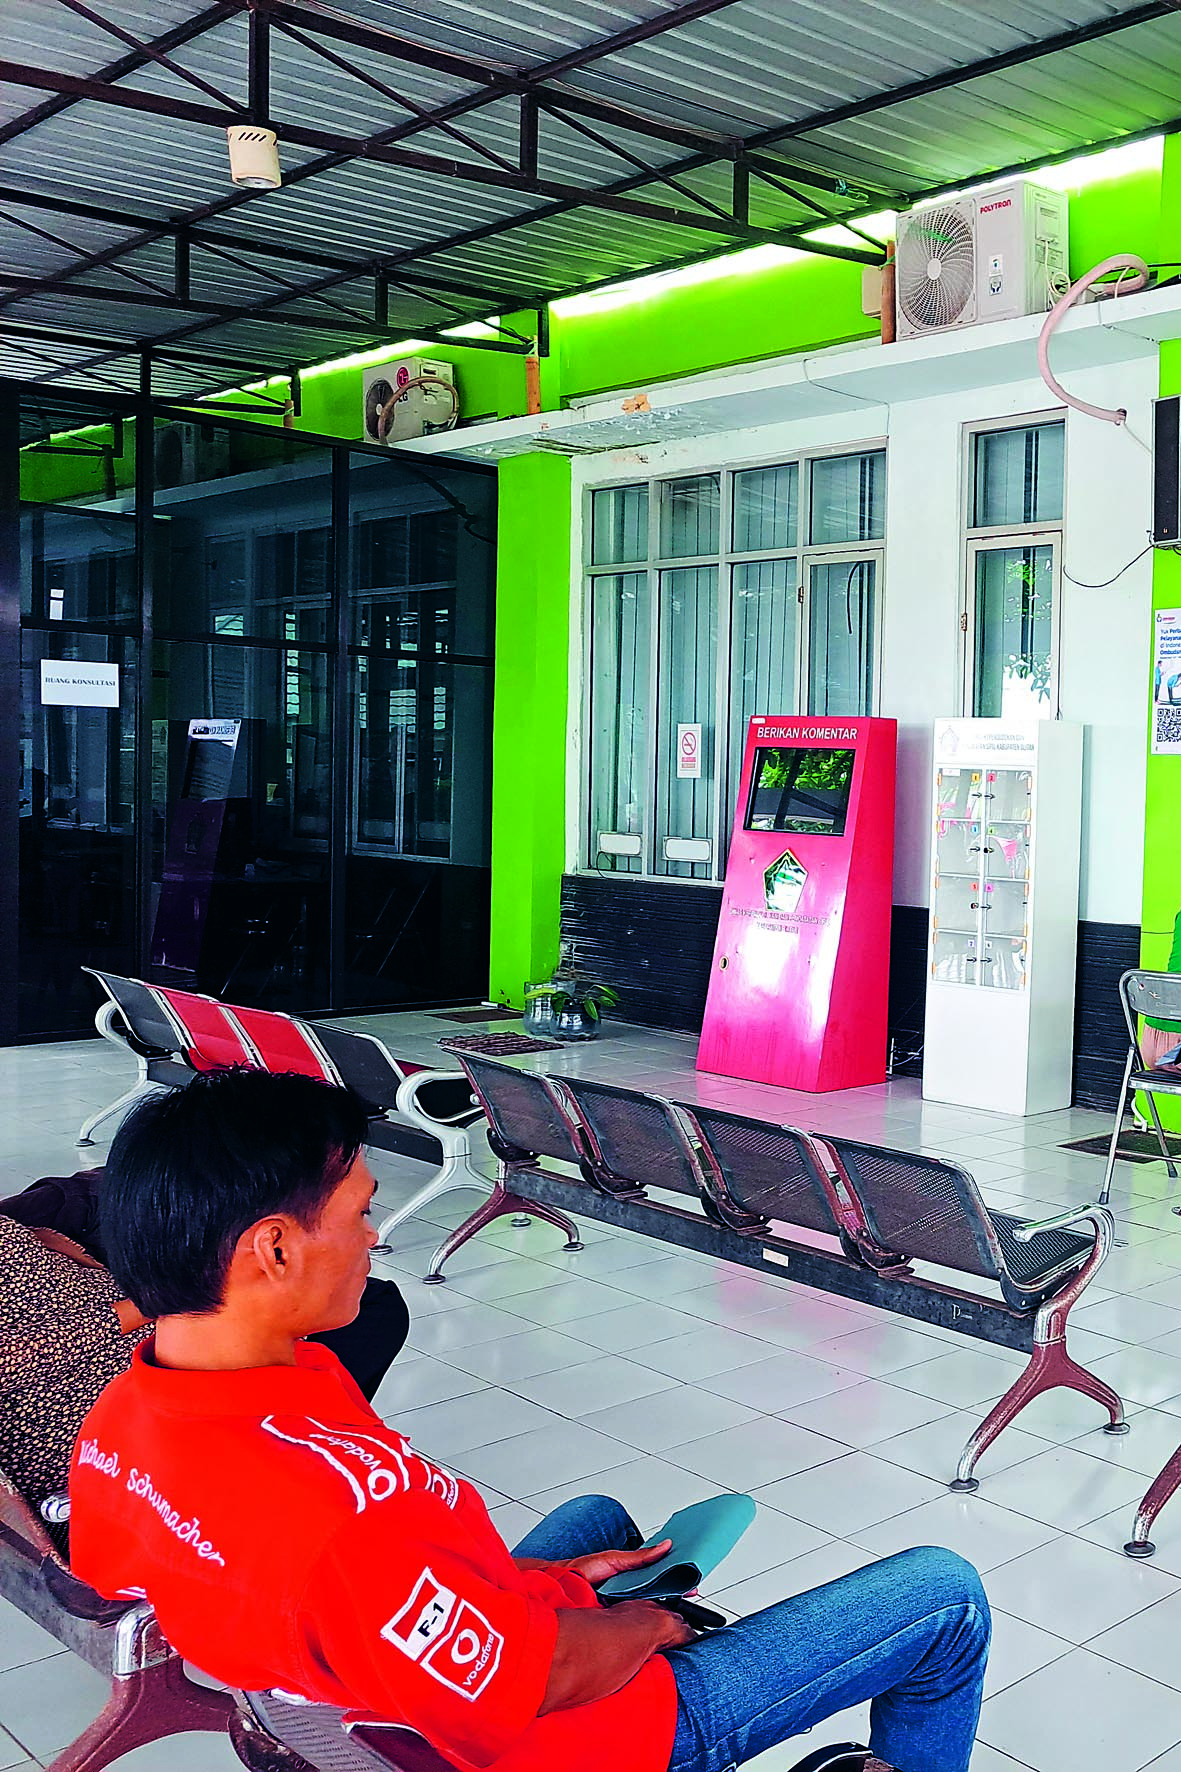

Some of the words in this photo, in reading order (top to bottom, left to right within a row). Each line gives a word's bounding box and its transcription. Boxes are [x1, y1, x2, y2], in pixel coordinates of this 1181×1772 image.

[980, 199, 1012, 214] POLYTRON
[72, 678, 116, 686] KONSULTASI
[757, 727, 800, 739] BERIKAN
[801, 727, 858, 740] KOMENTAR
[309, 1433, 382, 1471] vodaf
[417, 1602, 445, 1638] F-1
[462, 1633, 495, 1686] vodafone
